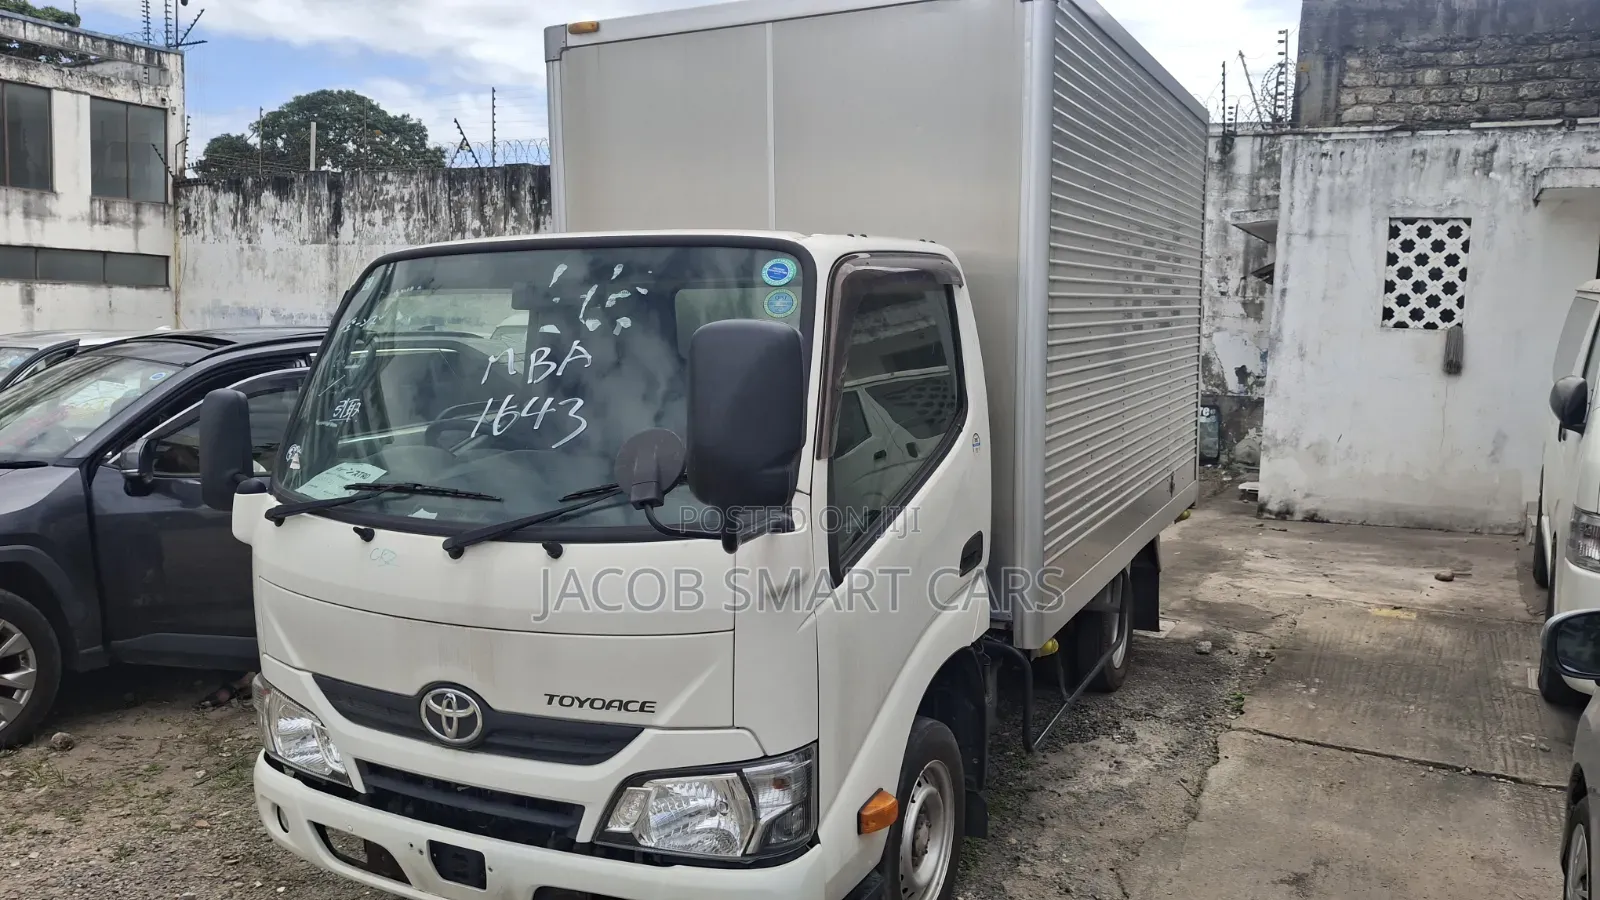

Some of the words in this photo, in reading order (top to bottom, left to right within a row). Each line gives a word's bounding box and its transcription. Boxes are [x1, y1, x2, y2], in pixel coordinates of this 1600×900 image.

[481, 339, 592, 385] MBA
[470, 393, 588, 449] 1643
[543, 693, 658, 714] TOYOACE
